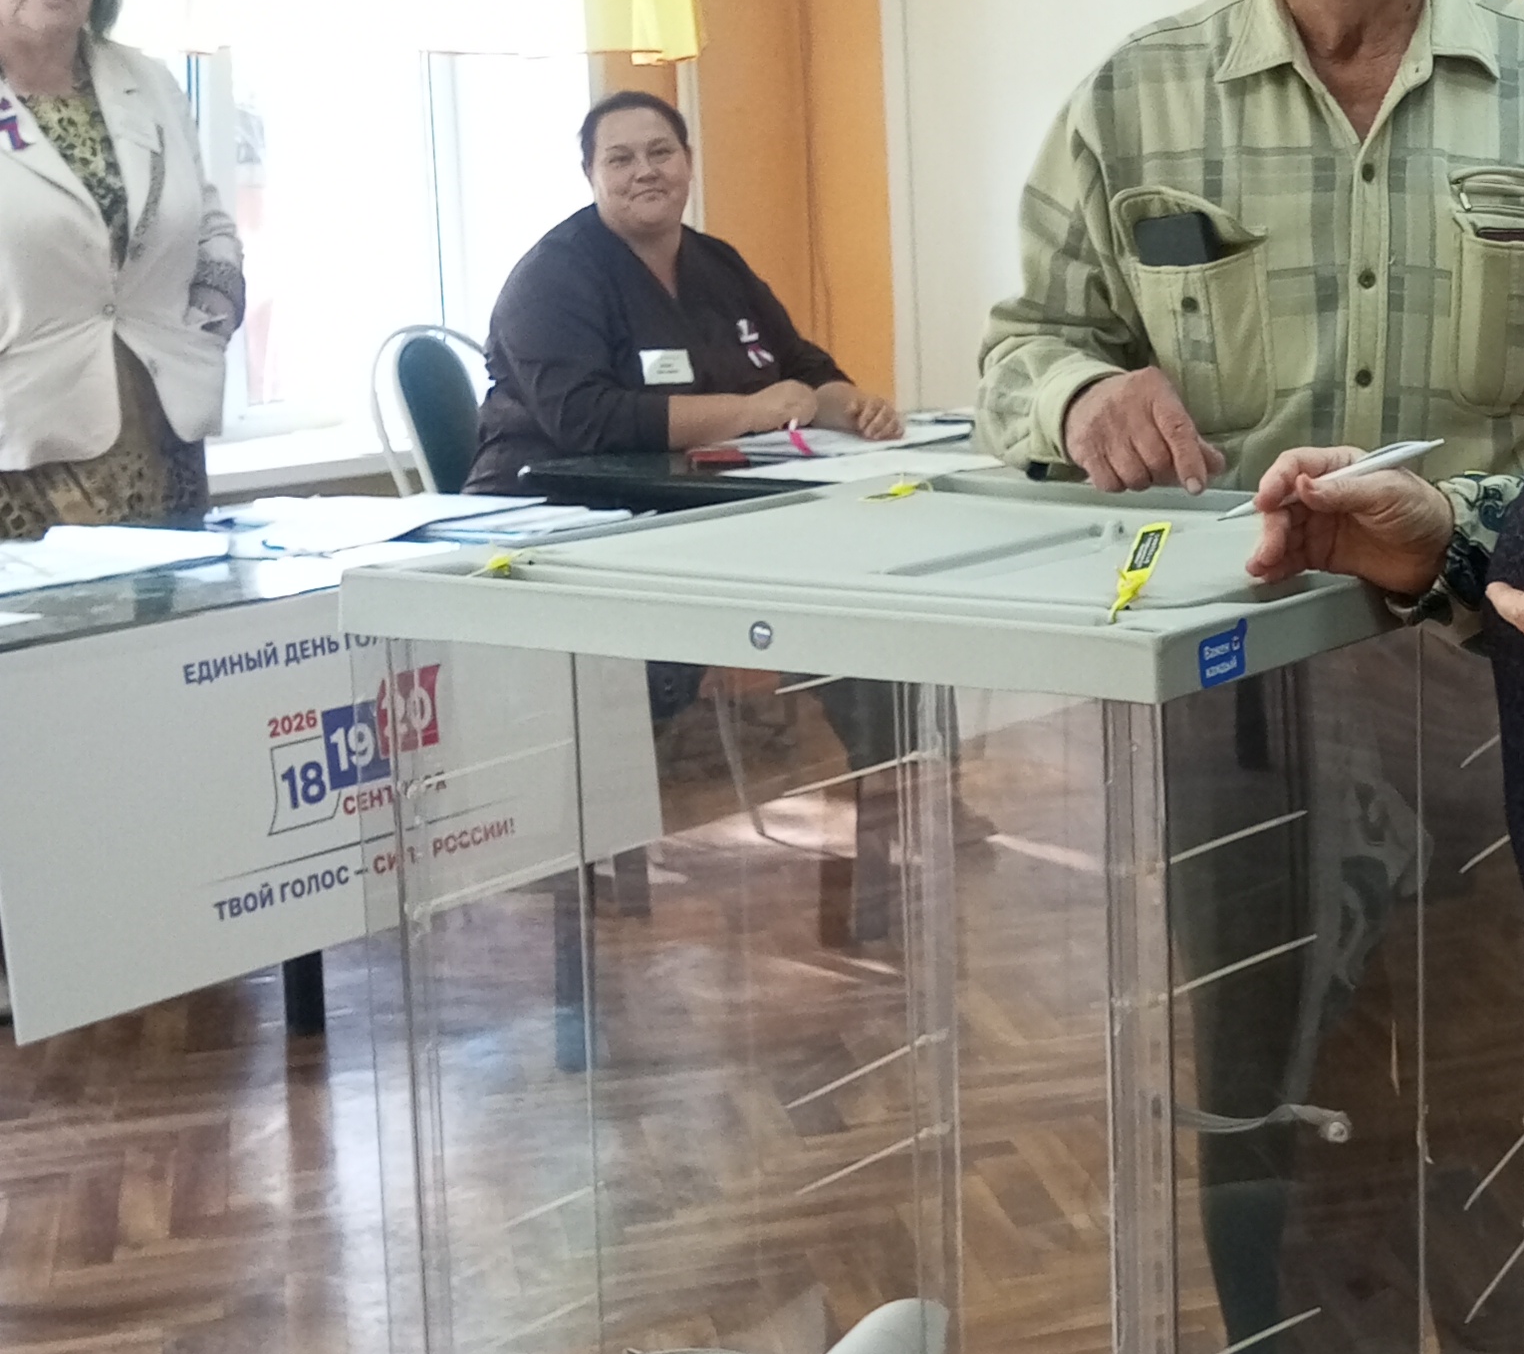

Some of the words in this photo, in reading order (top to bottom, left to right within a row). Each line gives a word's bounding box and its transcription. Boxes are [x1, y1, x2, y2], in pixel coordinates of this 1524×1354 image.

[183, 641, 279, 684] ЕДИНЫЙ
[285, 634, 340, 666] ДЕНЬ
[268, 710, 318, 738] 2026
[330, 722, 375, 772] 19
[281, 761, 327, 810] 18
[214, 882, 274, 921] ТВОЙ
[279, 865, 350, 902] ГОЛОС
[432, 817, 515, 858] РОССИИ!
